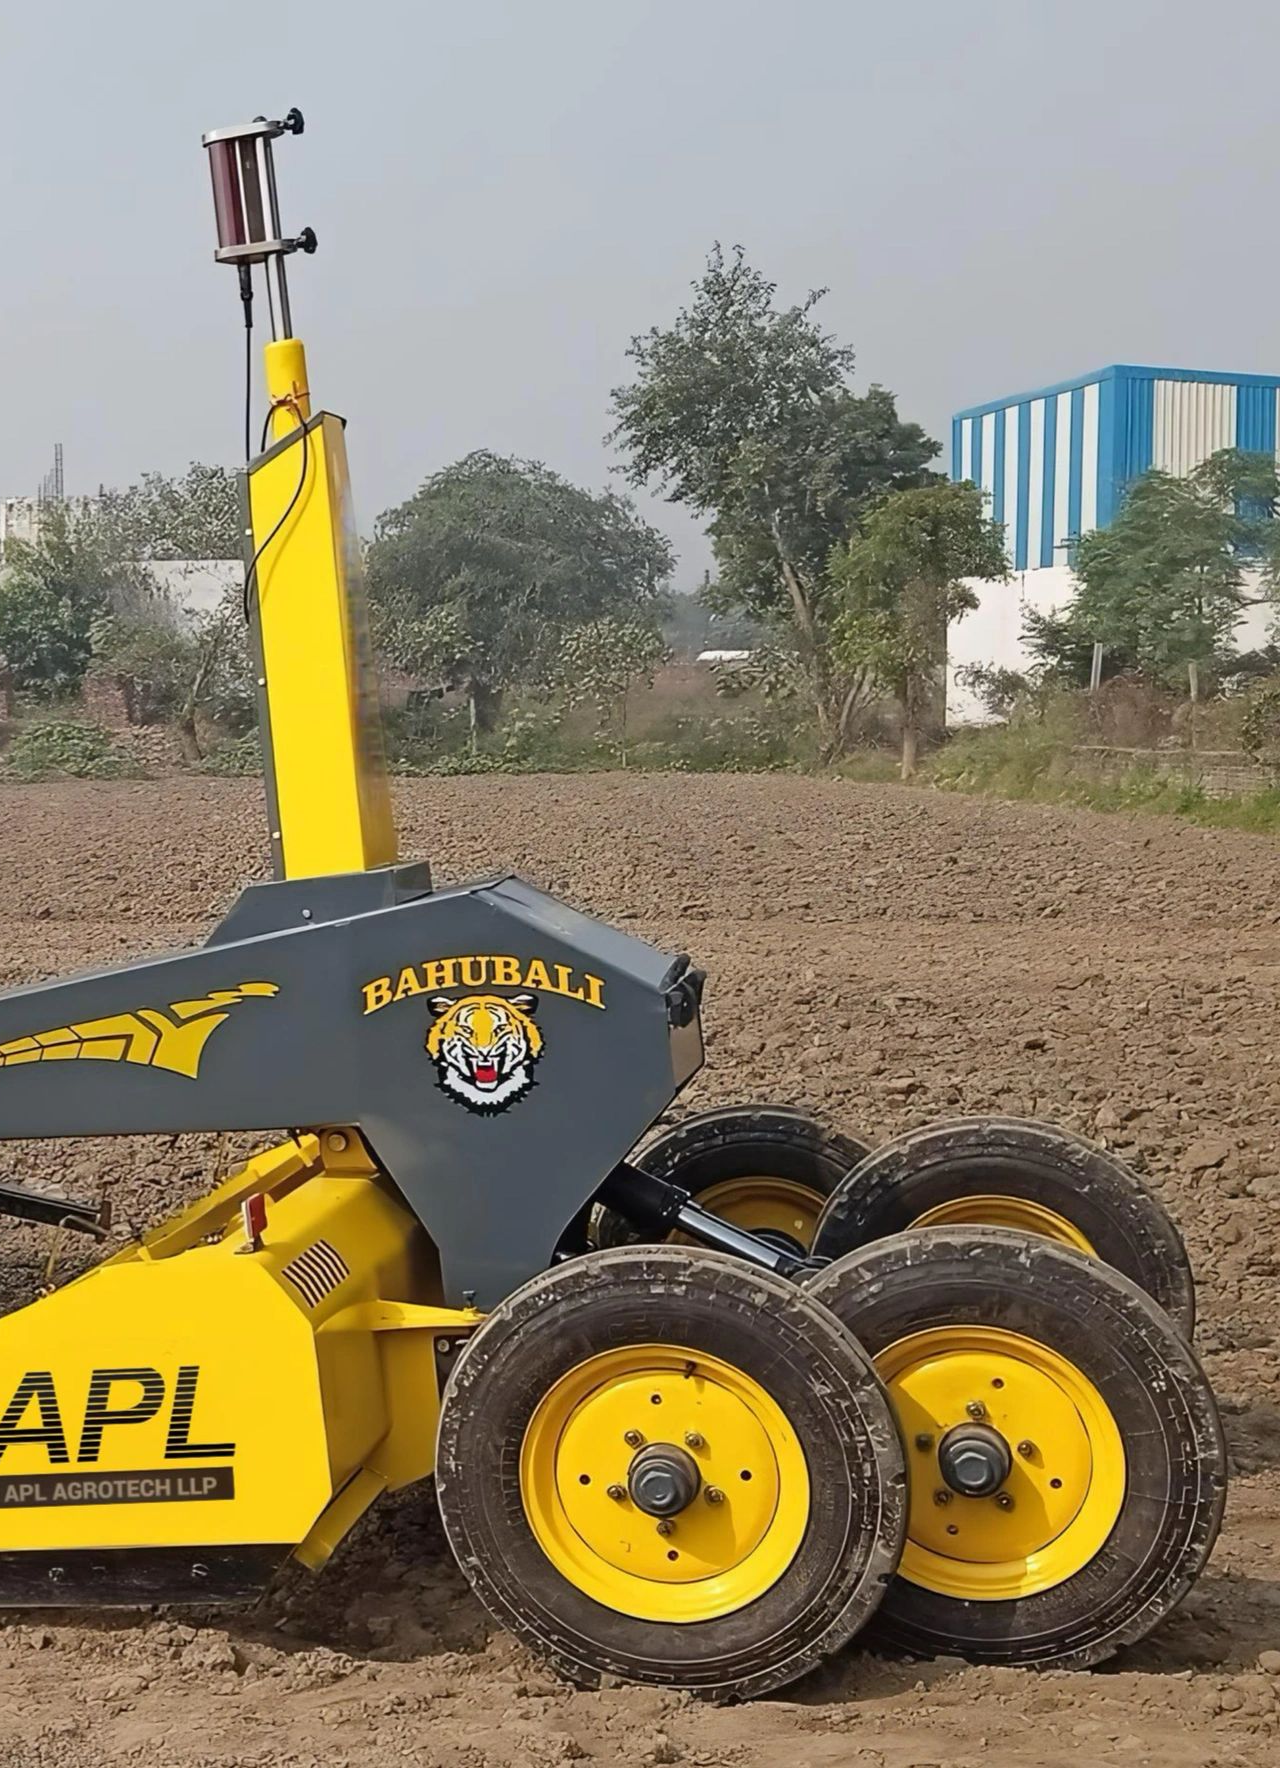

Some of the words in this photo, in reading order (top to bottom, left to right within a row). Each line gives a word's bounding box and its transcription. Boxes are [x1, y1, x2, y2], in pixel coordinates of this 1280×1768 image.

[361, 953, 607, 1015] BAHUBALI
[4, 1484, 47, 1503] APL
[52, 1478, 171, 1501] AGROTECH
[176, 1476, 218, 1496] LLP
